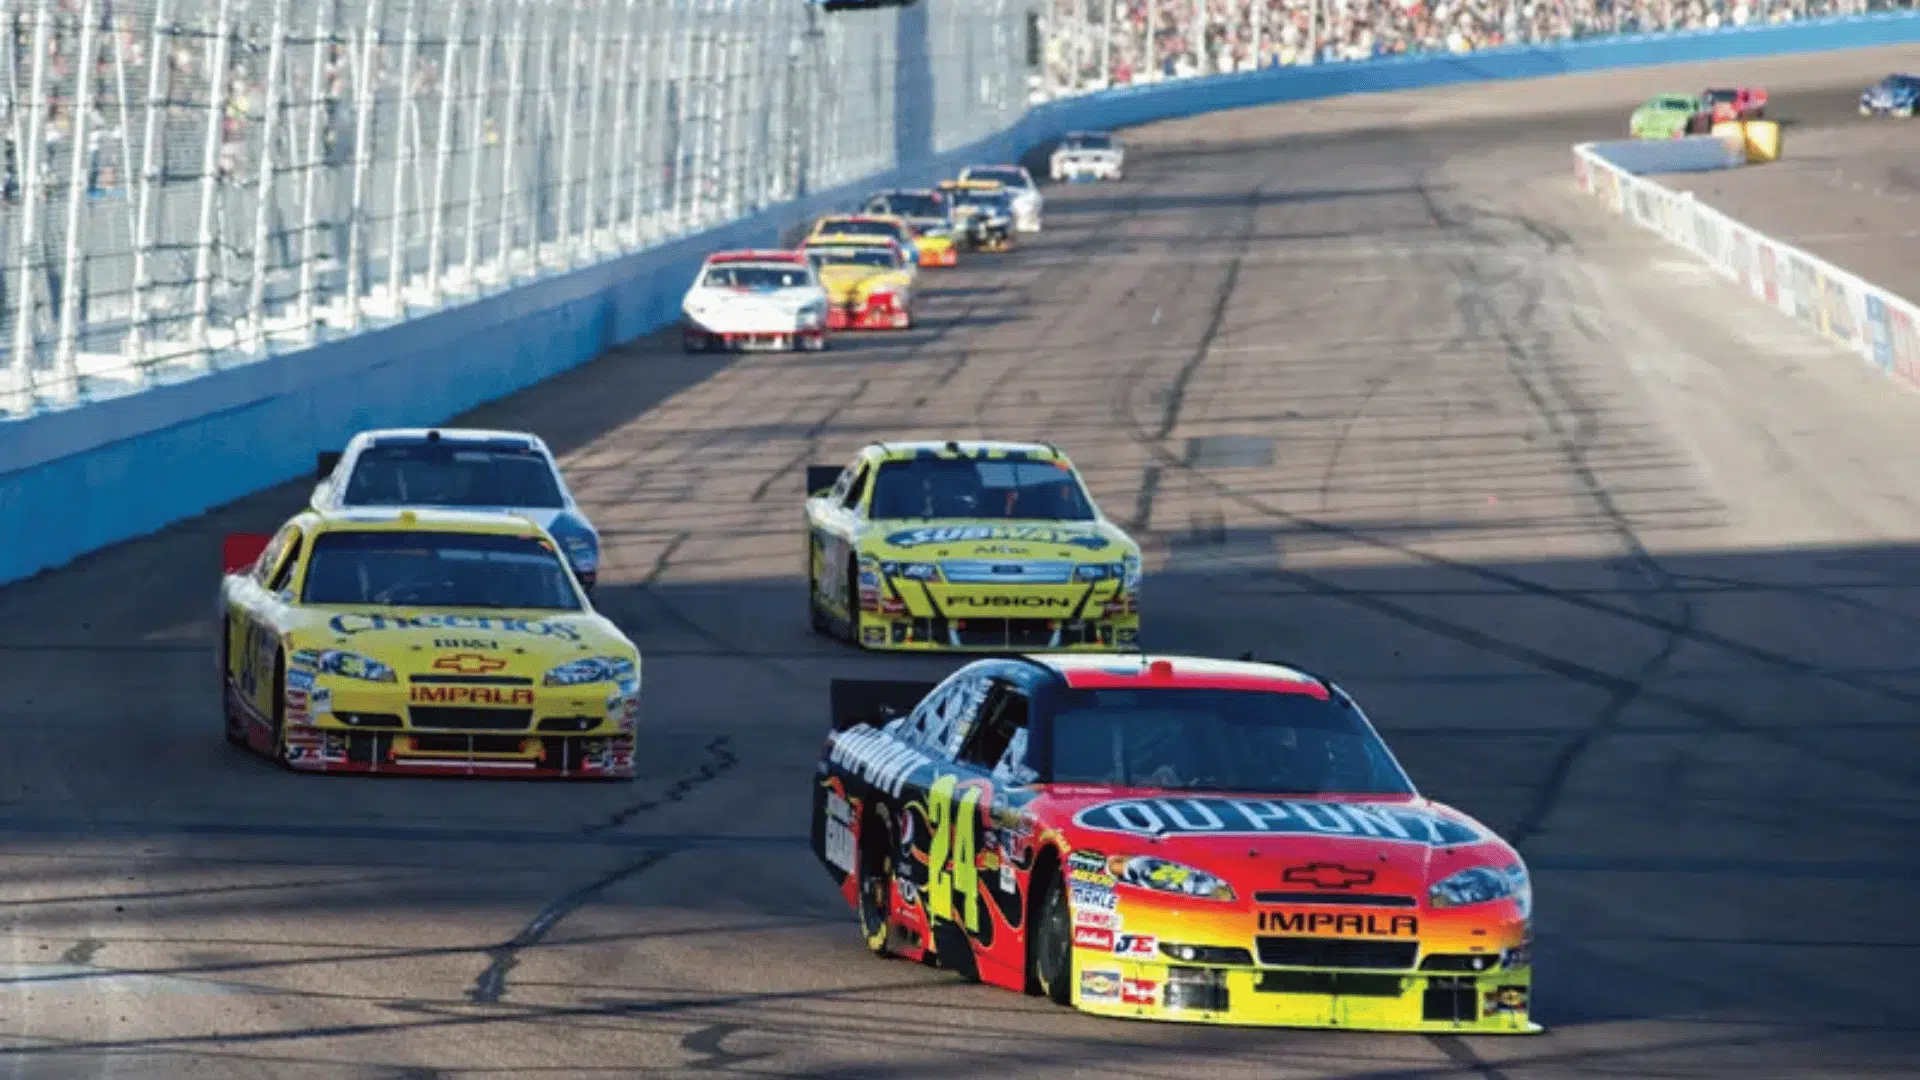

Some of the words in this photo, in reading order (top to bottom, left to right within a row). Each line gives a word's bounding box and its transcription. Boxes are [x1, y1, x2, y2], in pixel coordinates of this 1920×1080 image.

[947, 595, 1070, 608] FUSION
[410, 686, 535, 705] IMPALA
[928, 774, 980, 933] 24
[1258, 911, 1419, 936] IMPALA
[1115, 934, 1155, 953] JE
